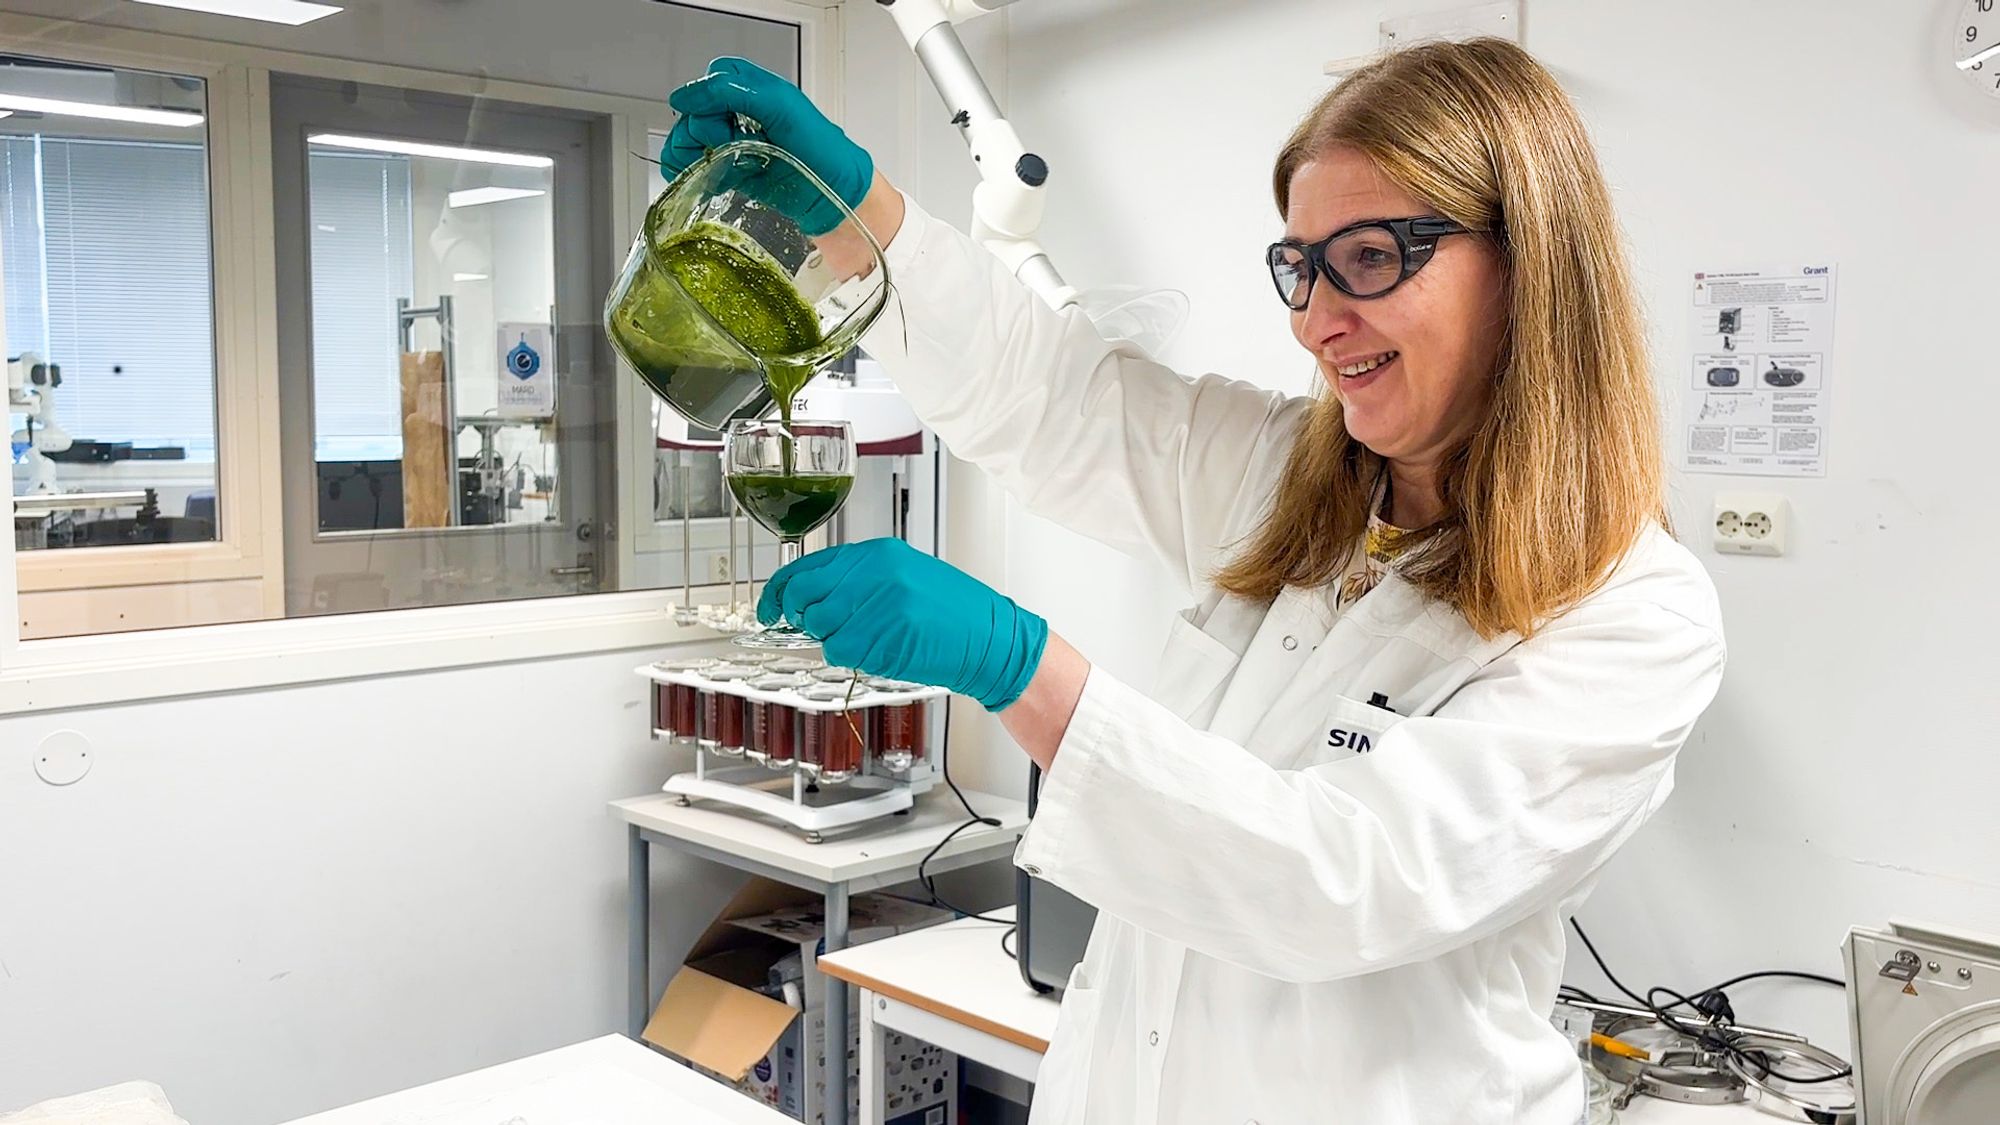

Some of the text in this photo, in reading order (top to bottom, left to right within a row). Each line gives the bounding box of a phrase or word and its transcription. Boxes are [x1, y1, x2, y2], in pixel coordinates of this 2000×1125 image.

[1975, 0, 1993, 12] 10
[1966, 26, 1977, 42] 9
[1803, 266, 1828, 275] Grant
